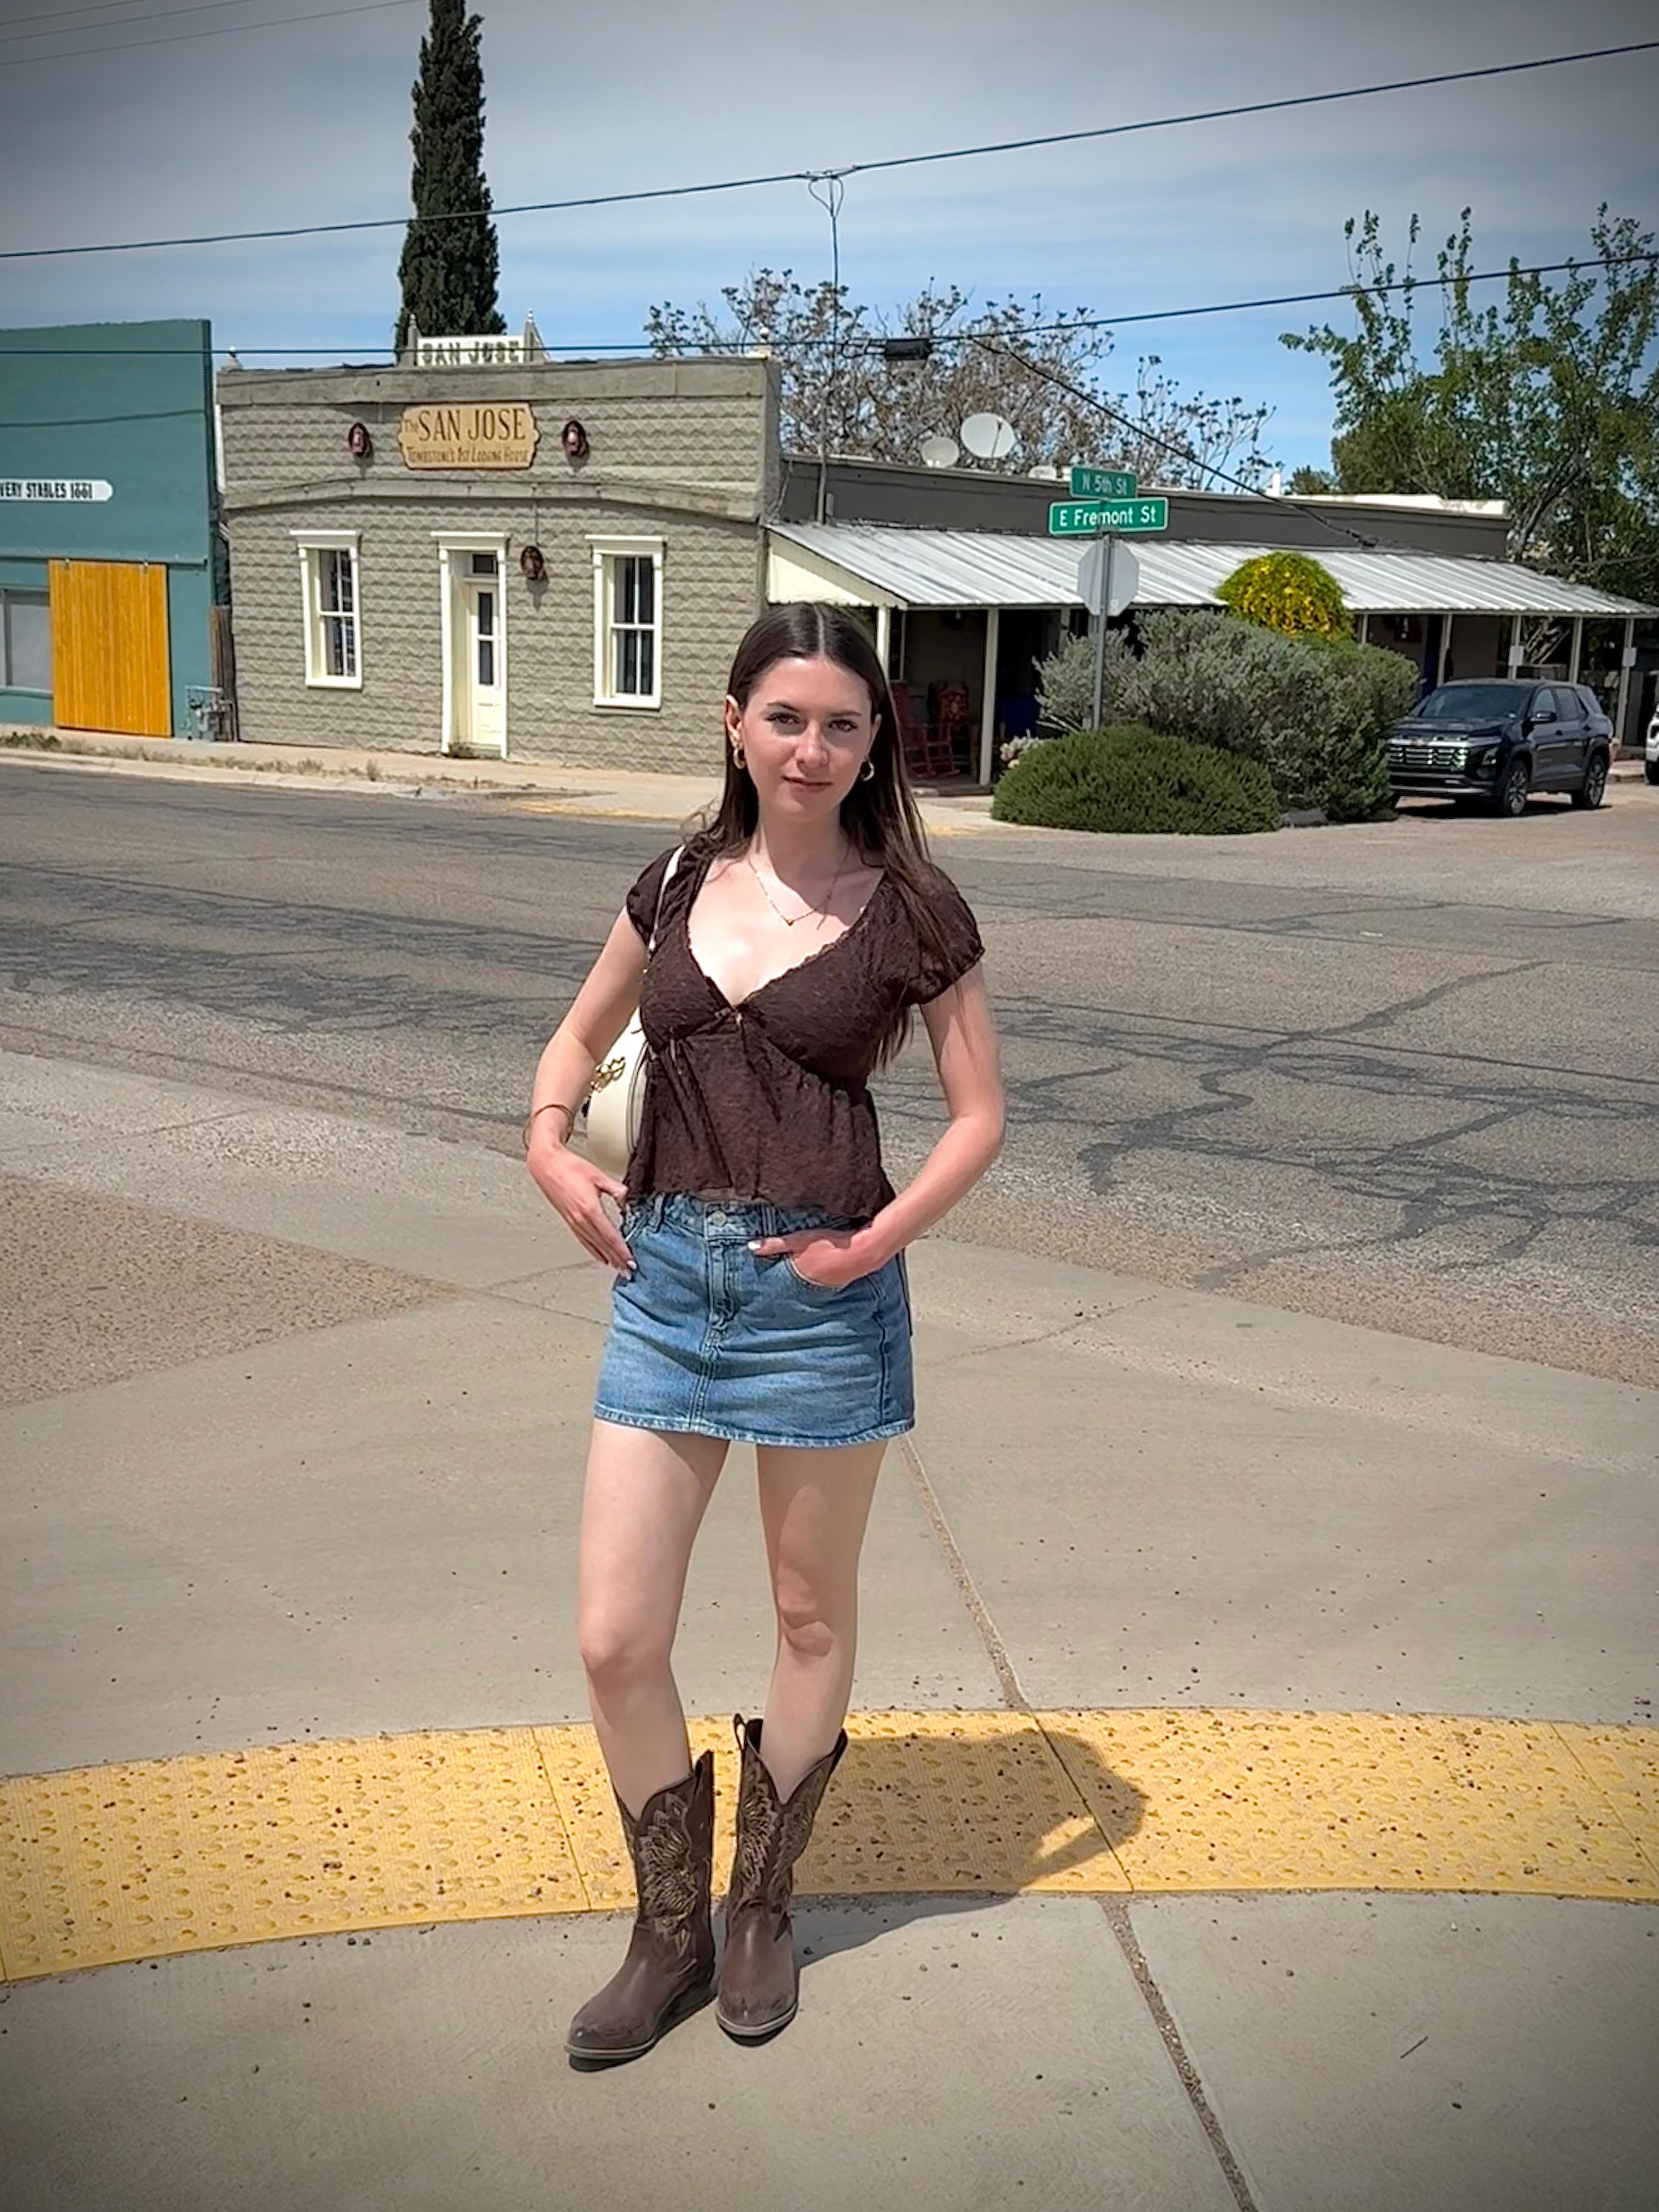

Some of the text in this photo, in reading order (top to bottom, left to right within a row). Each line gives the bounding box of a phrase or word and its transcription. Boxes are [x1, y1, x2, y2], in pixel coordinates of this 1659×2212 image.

[422, 340, 519, 364] SAN JOSE
[419, 410, 460, 441] SAN
[468, 409, 526, 440] JOSE
[26, 482, 67, 498] STABLES
[1082, 472, 1128, 495] N 5th St
[1060, 505, 1156, 527] E Fremont St
